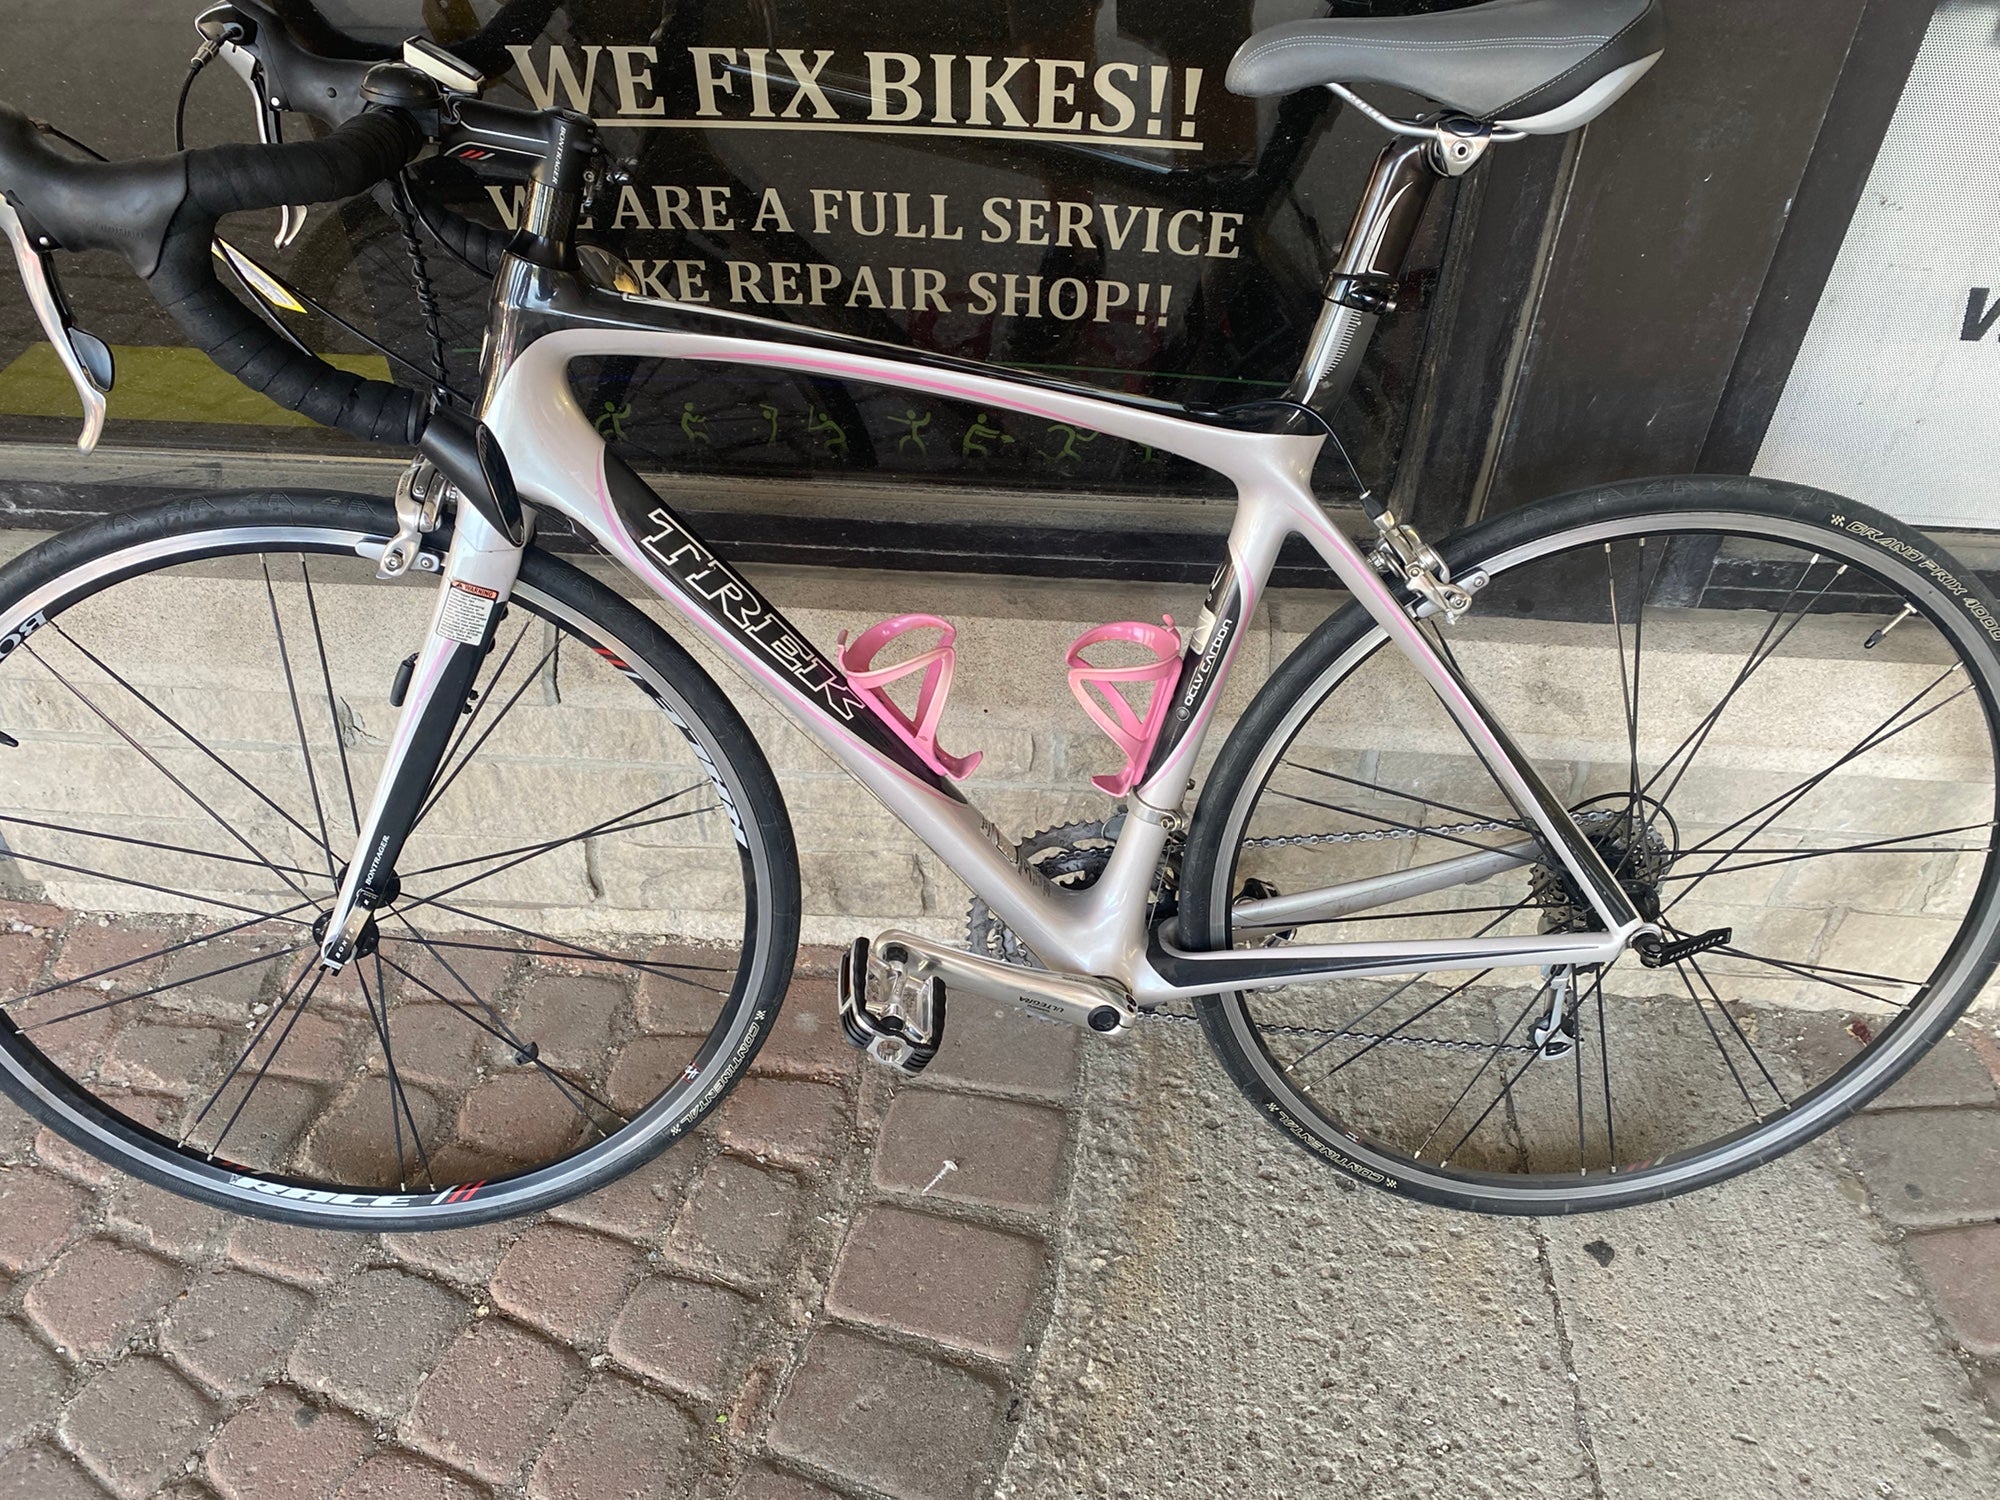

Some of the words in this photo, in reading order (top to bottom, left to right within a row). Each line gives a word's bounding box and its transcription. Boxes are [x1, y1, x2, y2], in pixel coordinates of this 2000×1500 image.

[505, 45, 665, 116] WE
[687, 47, 841, 119] FIX
[864, 51, 1204, 138] BIKES!!
[552, 126, 567, 185] BONTRAGER
[484, 185, 594, 231] W
[611, 185, 735, 231] ARE
[751, 187, 793, 232] A
[809, 189, 964, 240] FULL
[981, 197, 1244, 258] SERVICE
[628, 259, 711, 303] KE
[724, 261, 953, 313] REPAIR
[967, 271, 1173, 328] SHOP!!
[464, 584, 494, 598] WARNING
[1846, 520, 1923, 562] GRAND
[1918, 559, 1967, 596] PRIX
[641, 508, 866, 720] TREK
[1184, 673, 1205, 706] OCLV
[364, 834, 390, 886] BONTRAGER
[1019, 995, 1065, 1014] ULTEGRA
[680, 1021, 761, 1124] CONTINENTAL
[1279, 1111, 1385, 1183] CONTINENTAL
[236, 1175, 419, 1208] RACE
